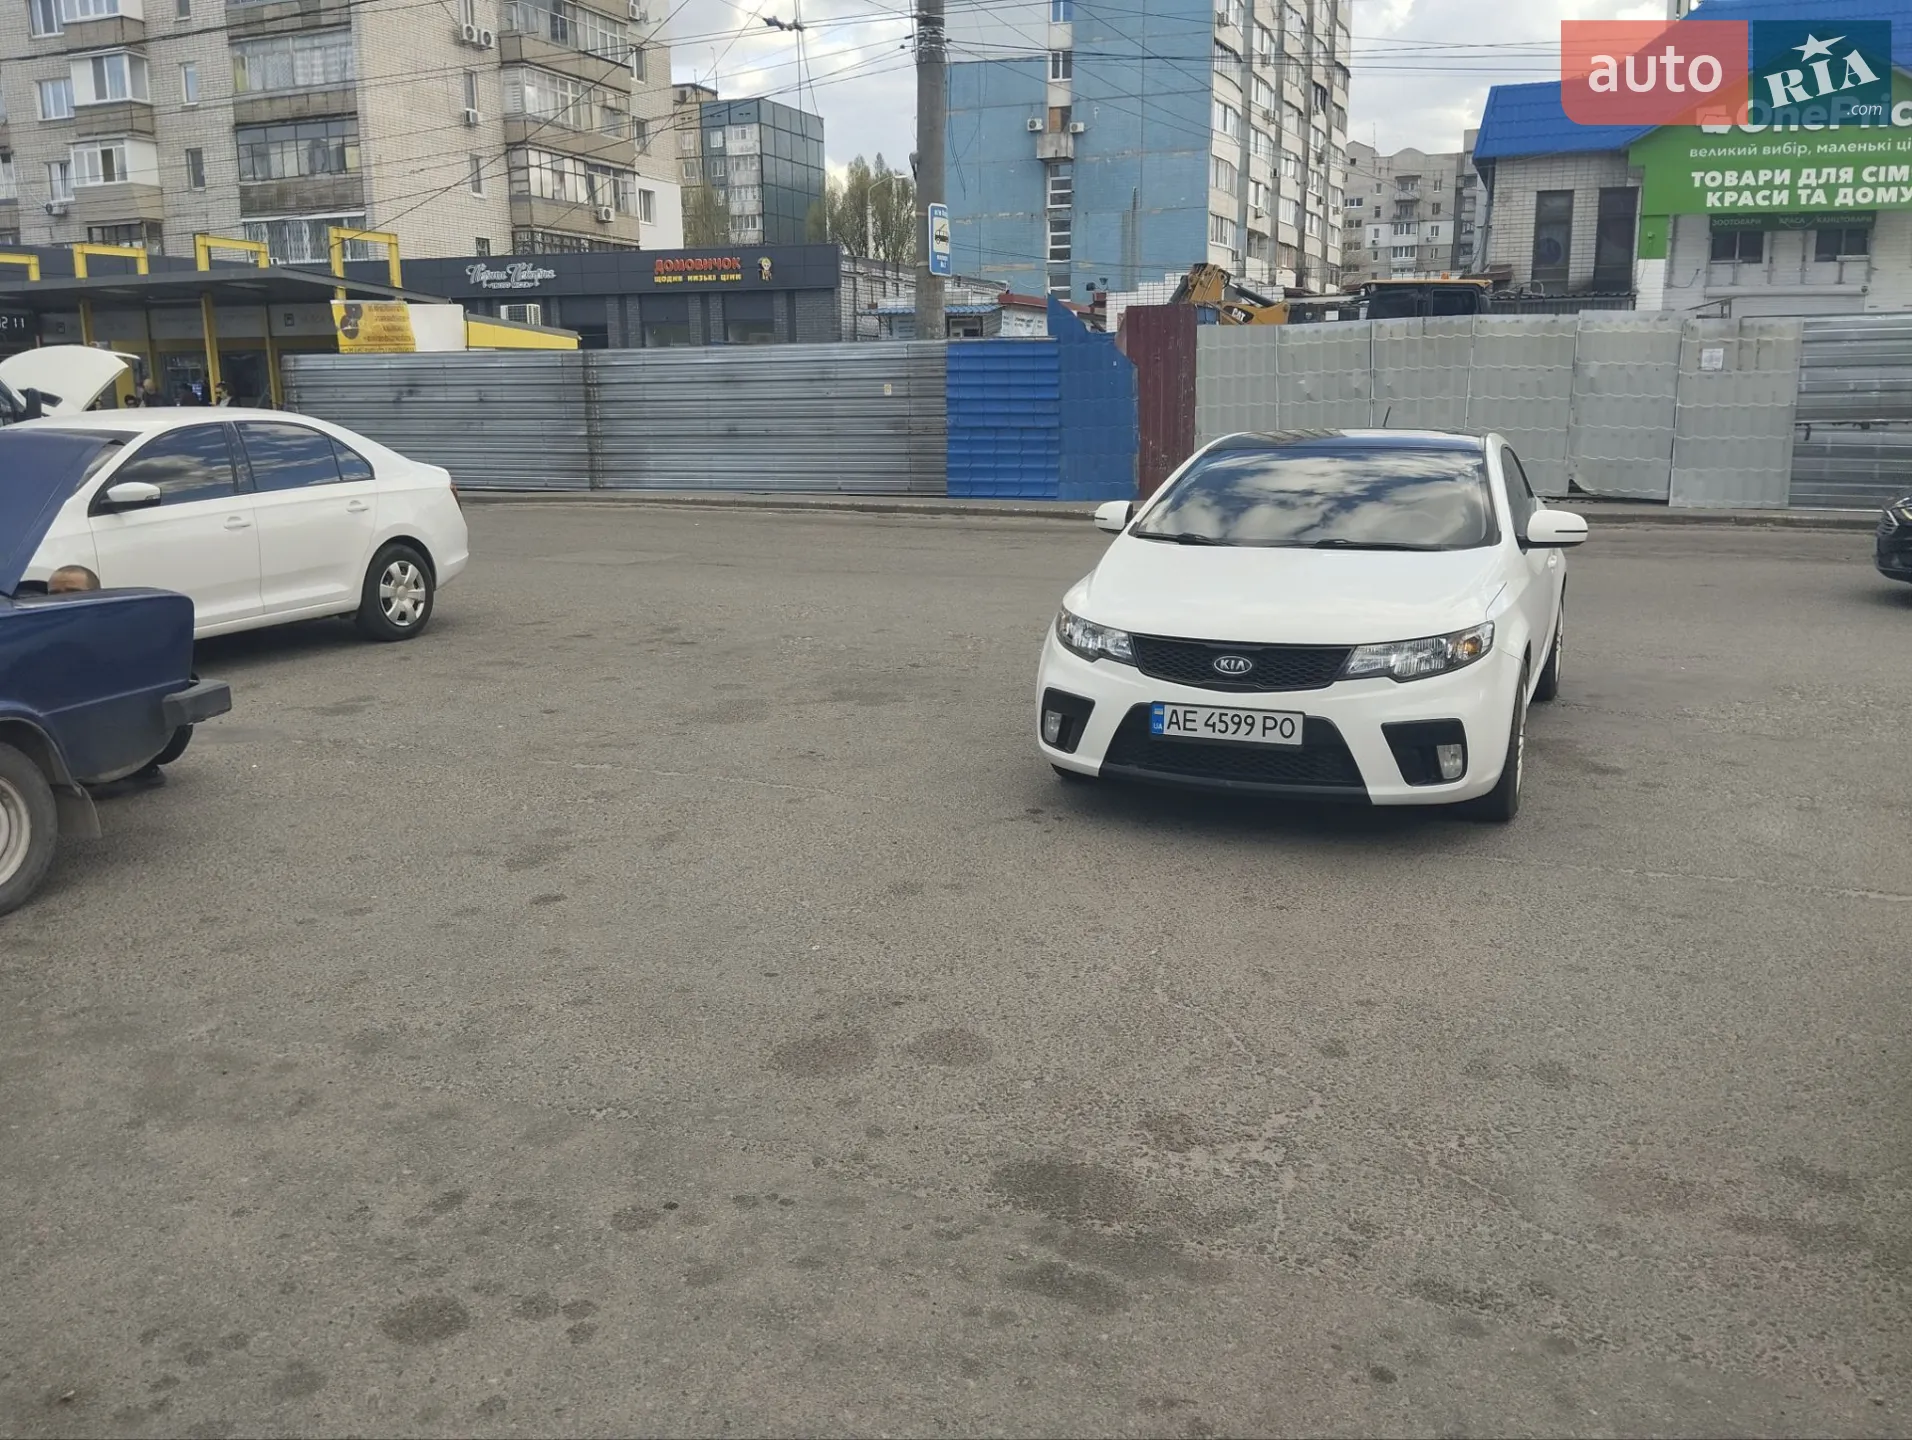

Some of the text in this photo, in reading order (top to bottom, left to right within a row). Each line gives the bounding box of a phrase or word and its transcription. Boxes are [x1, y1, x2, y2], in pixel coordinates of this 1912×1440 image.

[1689, 144, 1757, 158] великий
[1762, 141, 1812, 157] вибір,
[1816, 137, 1892, 154] маленькі
[1691, 168, 1791, 188] ТОВАРИ
[1797, 166, 1854, 188] ДЛЯ
[1706, 185, 1912, 208] КРАСИ ТА ДОМУ
[1711, 218, 1762, 227] ЗООТОВАРИ
[654, 257, 741, 275] ДОМОВИЧОК
[1232, 308, 1246, 321] CAT
[1219, 659, 1246, 671] KIA
[1166, 709, 1296, 739] AE 4599 PO
